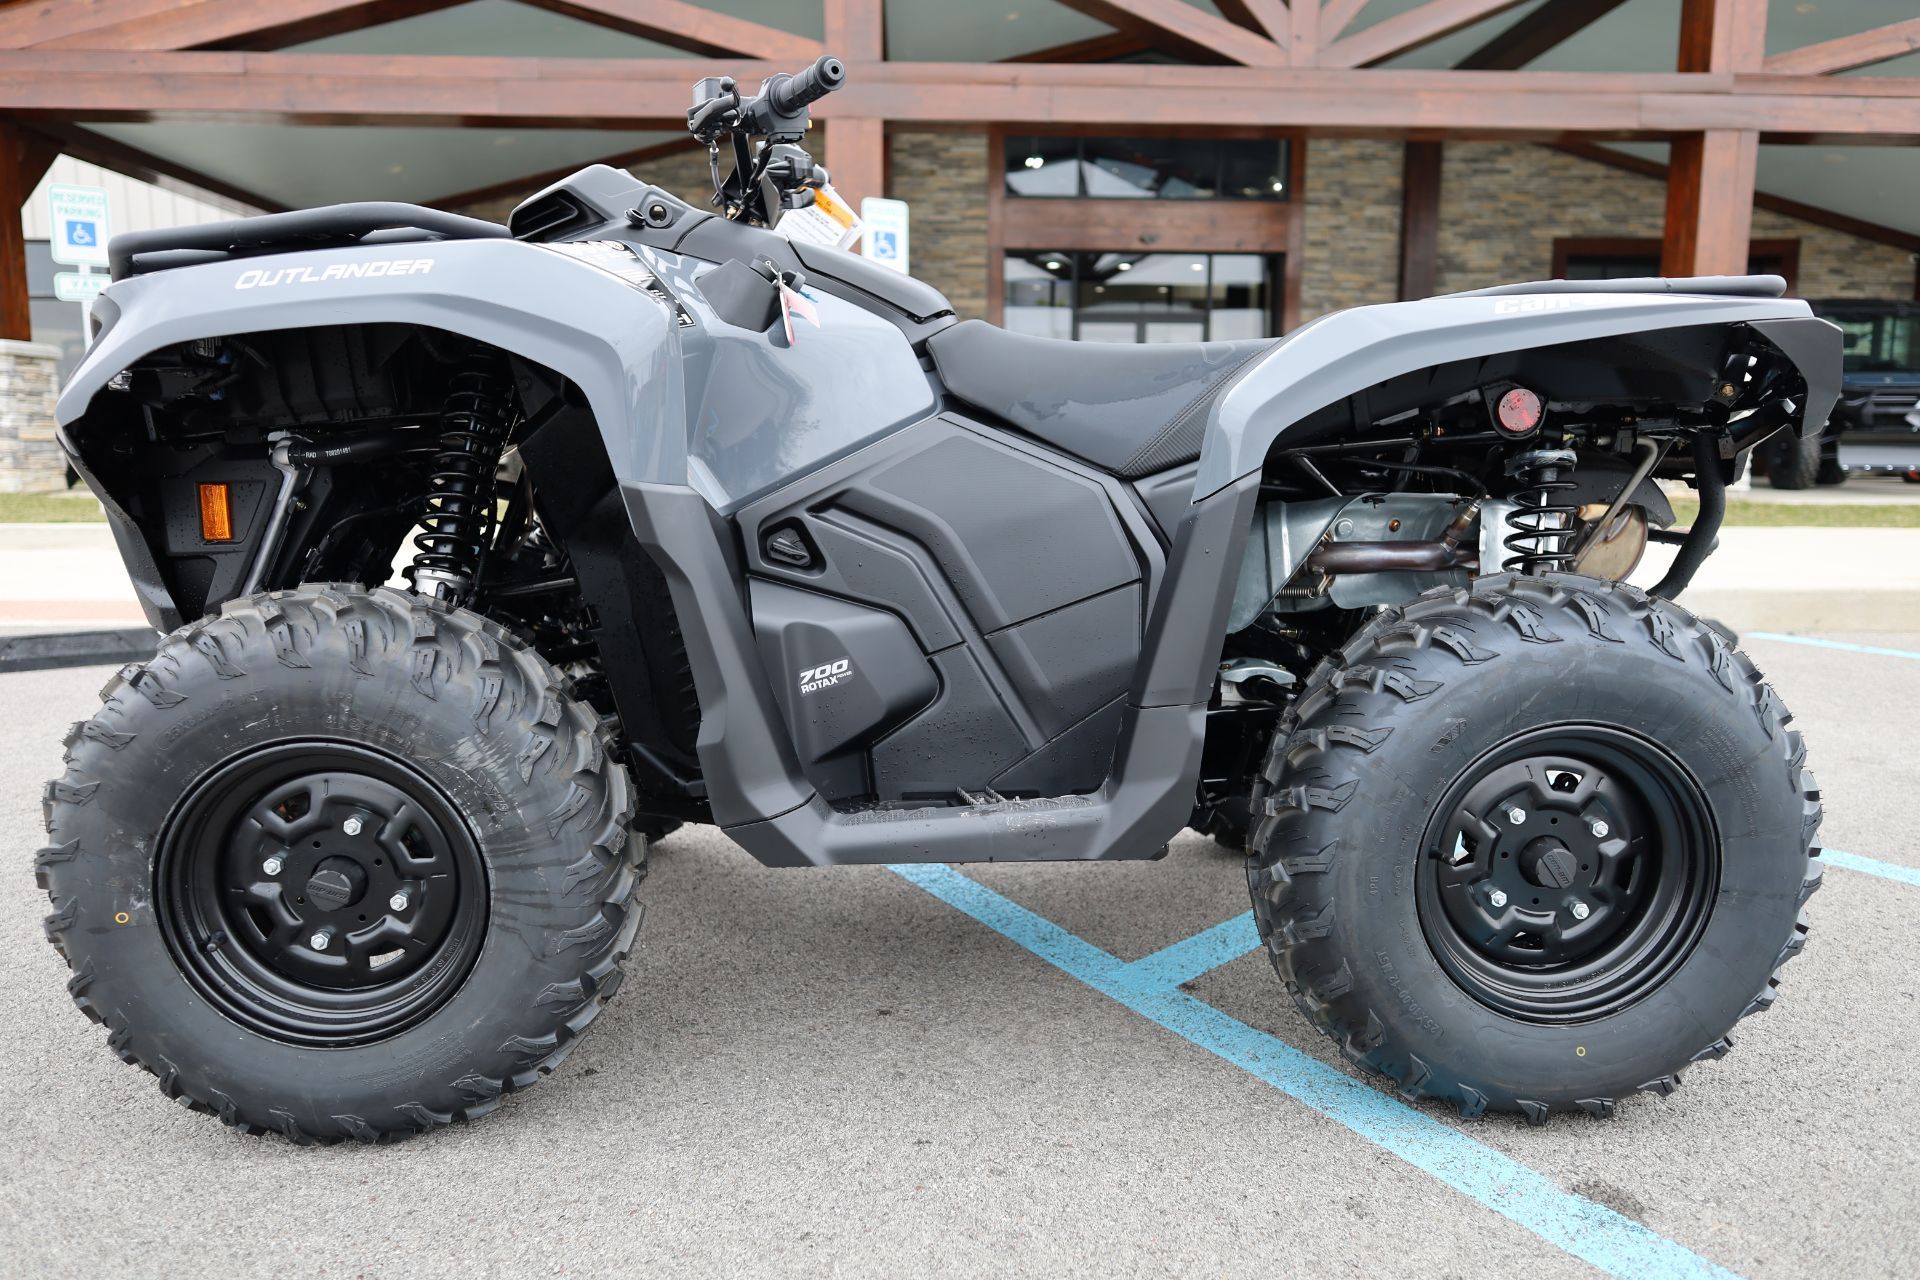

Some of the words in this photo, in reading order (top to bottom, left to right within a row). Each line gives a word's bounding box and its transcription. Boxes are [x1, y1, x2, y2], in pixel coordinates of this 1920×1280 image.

[234, 258, 435, 290] OUTLANDER
[800, 659, 849, 685] 700
[801, 675, 839, 694] ROTAX
